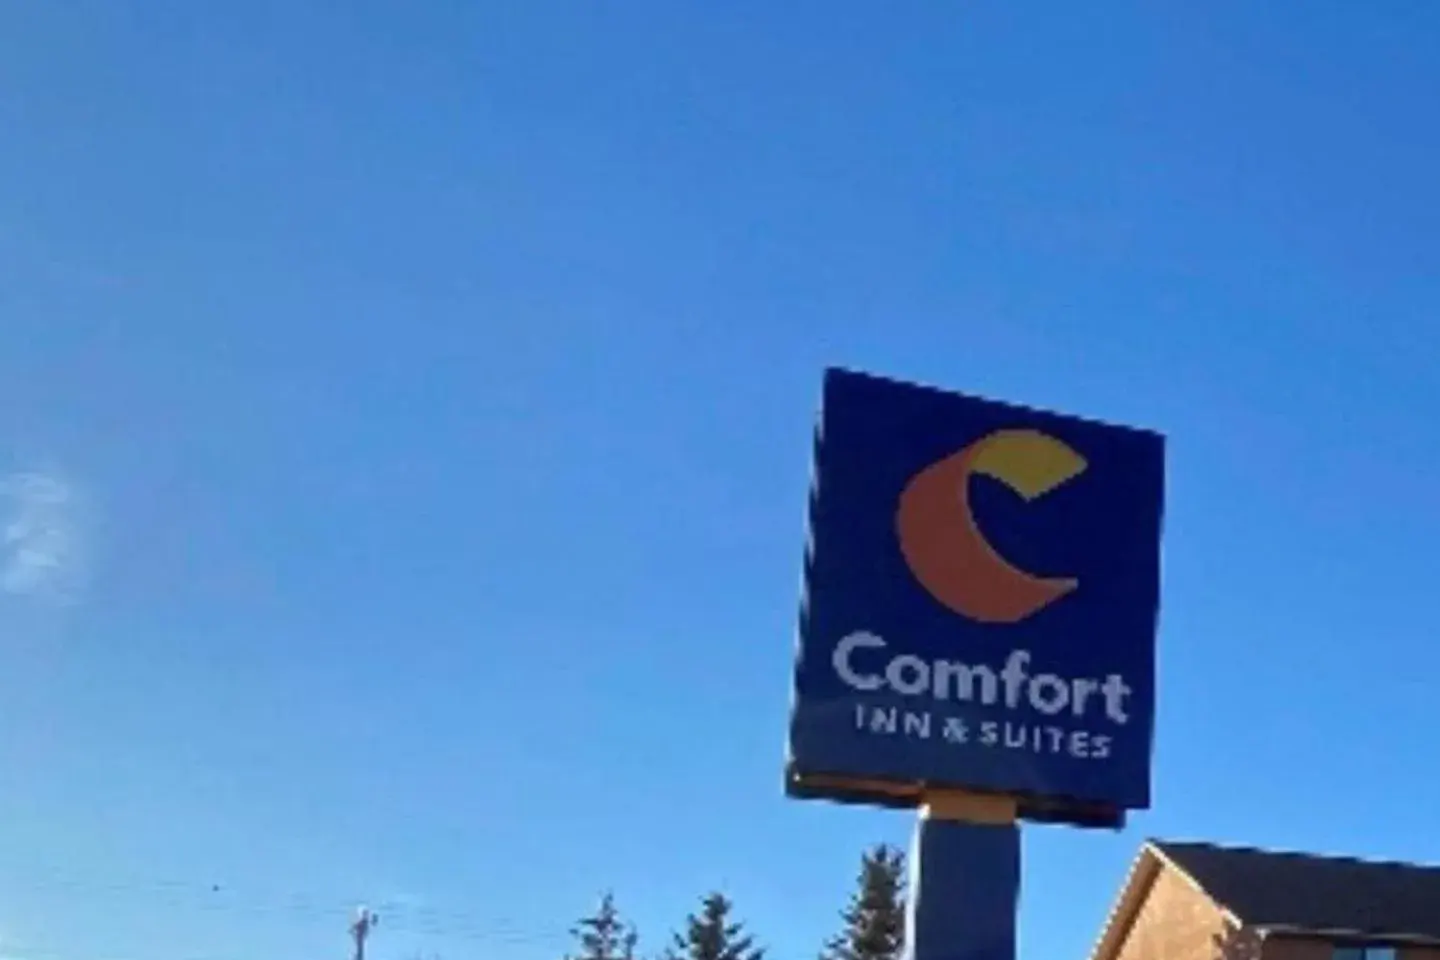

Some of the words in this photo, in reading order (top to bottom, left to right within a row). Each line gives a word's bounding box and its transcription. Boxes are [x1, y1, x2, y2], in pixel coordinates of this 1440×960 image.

[832, 630, 1131, 724] Comfort
[856, 704, 931, 738] INN
[943, 719, 968, 743] &
[979, 722, 1112, 758] SUITES
